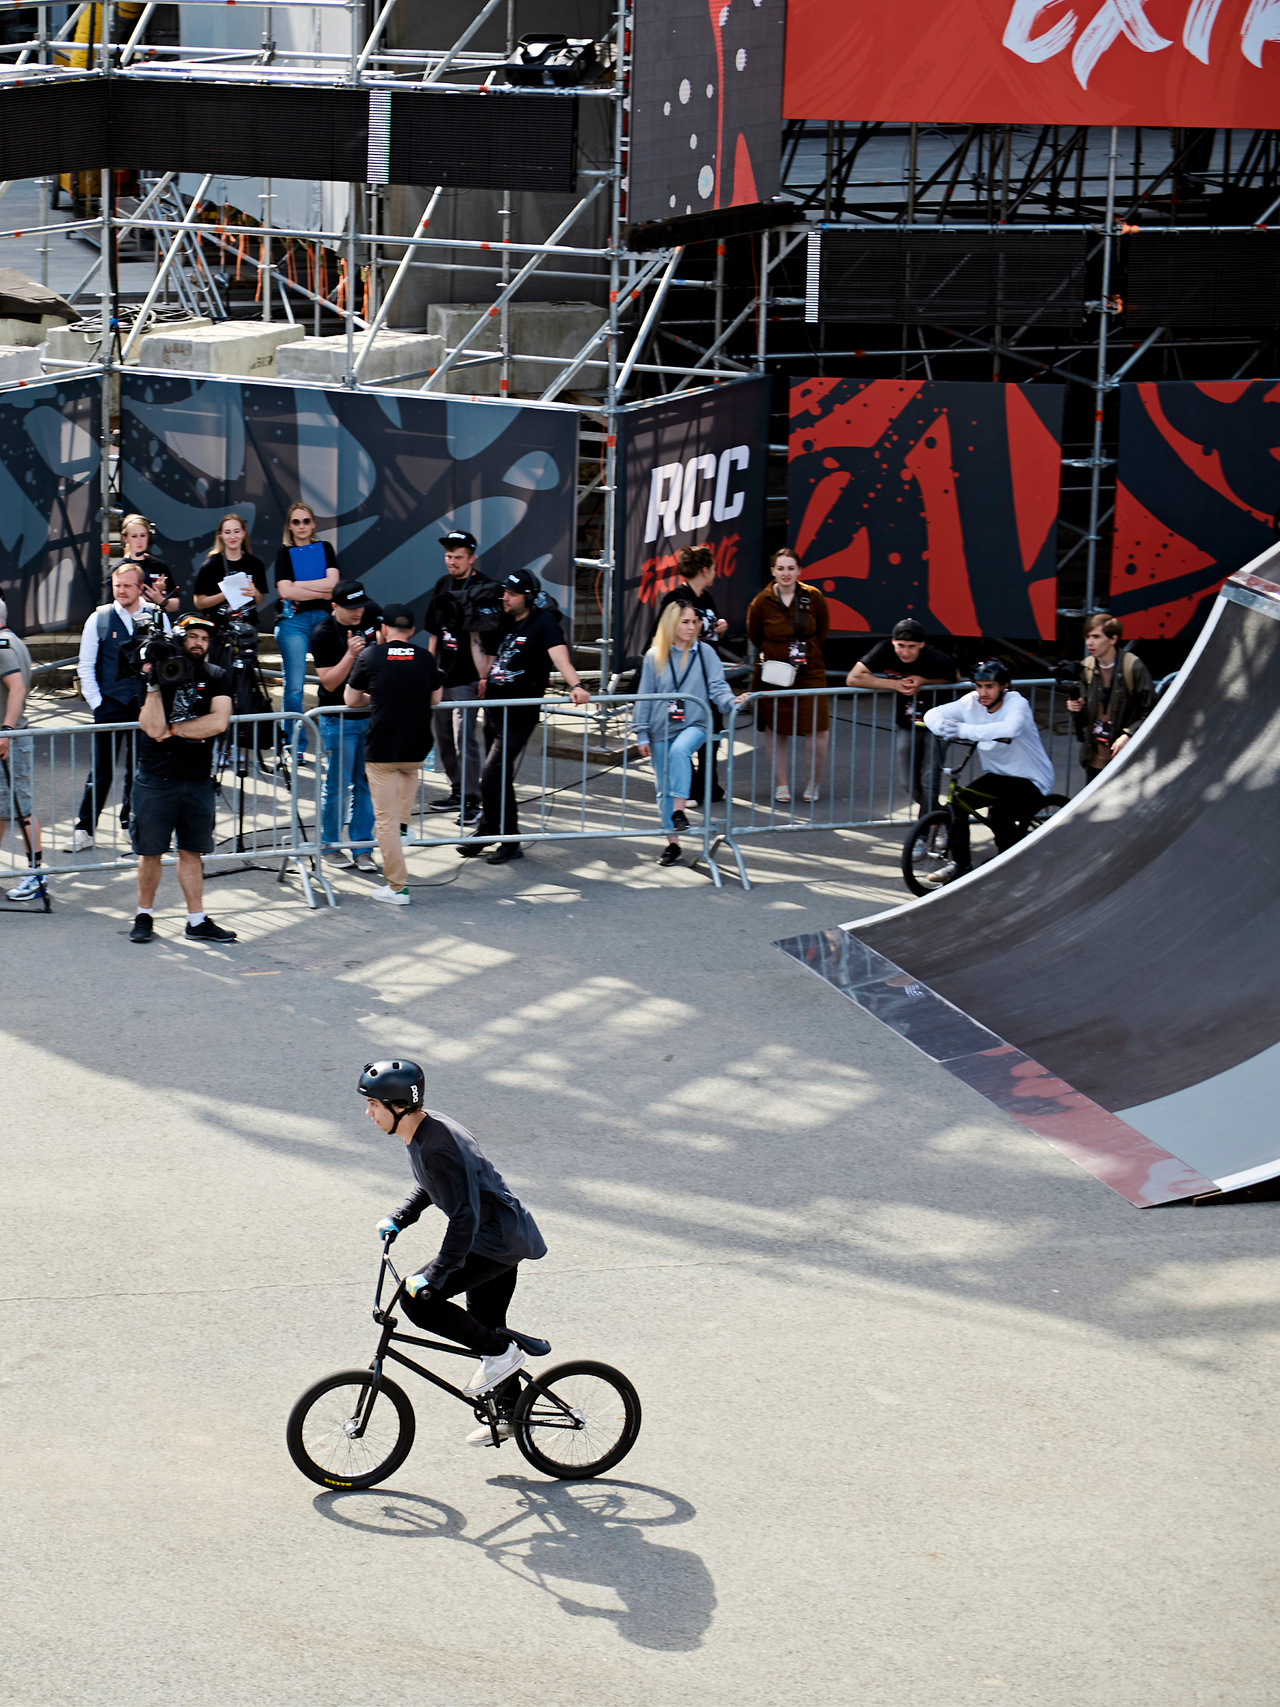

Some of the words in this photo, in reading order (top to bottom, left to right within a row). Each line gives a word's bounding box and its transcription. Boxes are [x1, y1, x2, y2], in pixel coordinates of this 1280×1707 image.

[644, 444, 750, 544] RCC
[637, 533, 741, 608] EXTME
[387, 647, 415, 656] RCC
